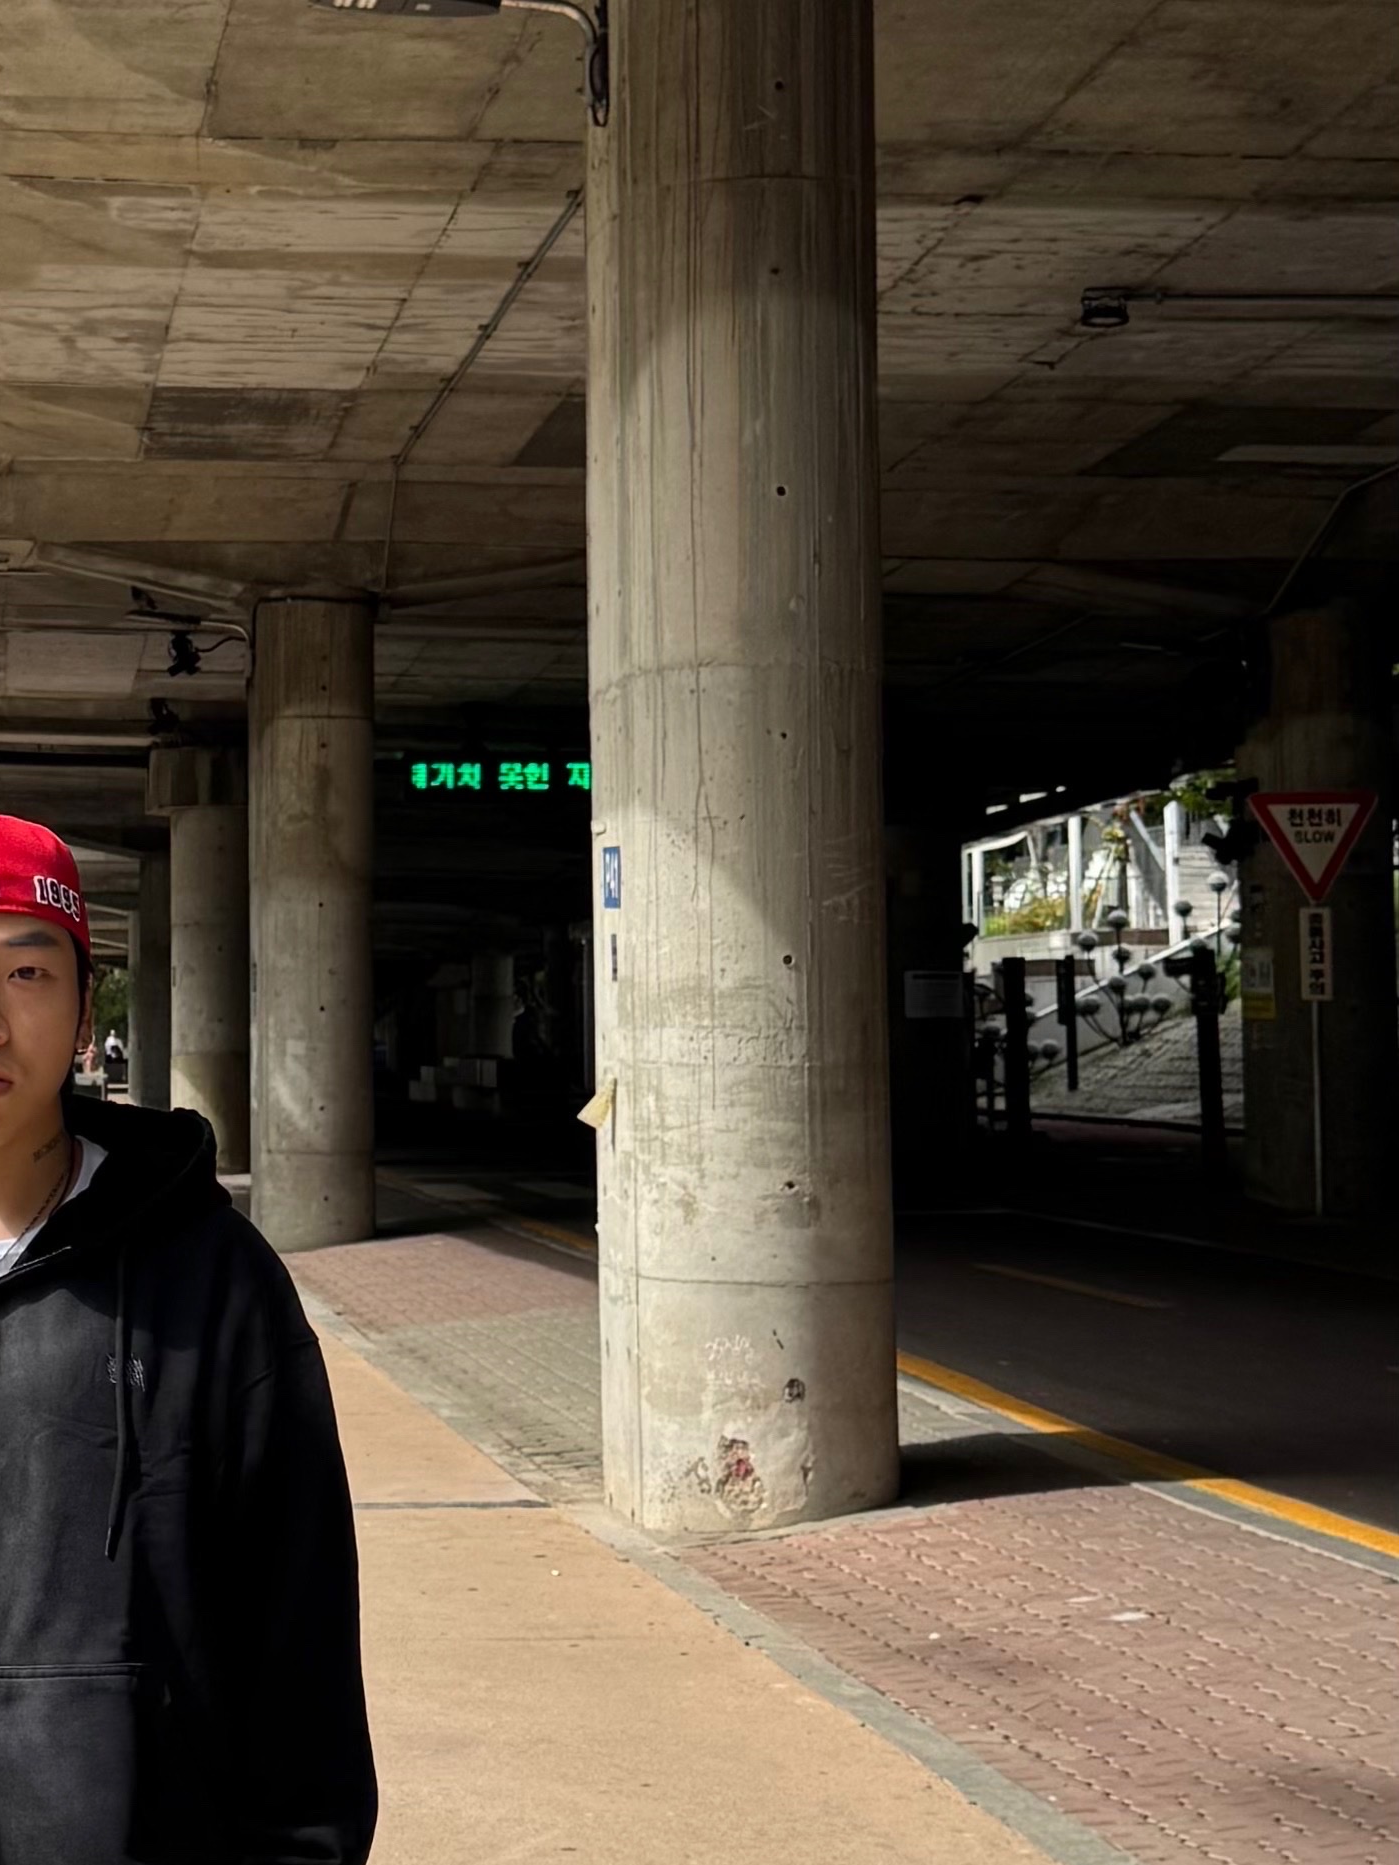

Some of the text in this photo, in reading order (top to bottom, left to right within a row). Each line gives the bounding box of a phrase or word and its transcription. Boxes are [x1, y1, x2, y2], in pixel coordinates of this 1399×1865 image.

[1288, 808, 1342, 827] 천천히
[1294, 830, 1335, 843] SLOW
[33, 875, 80, 922] 1995
